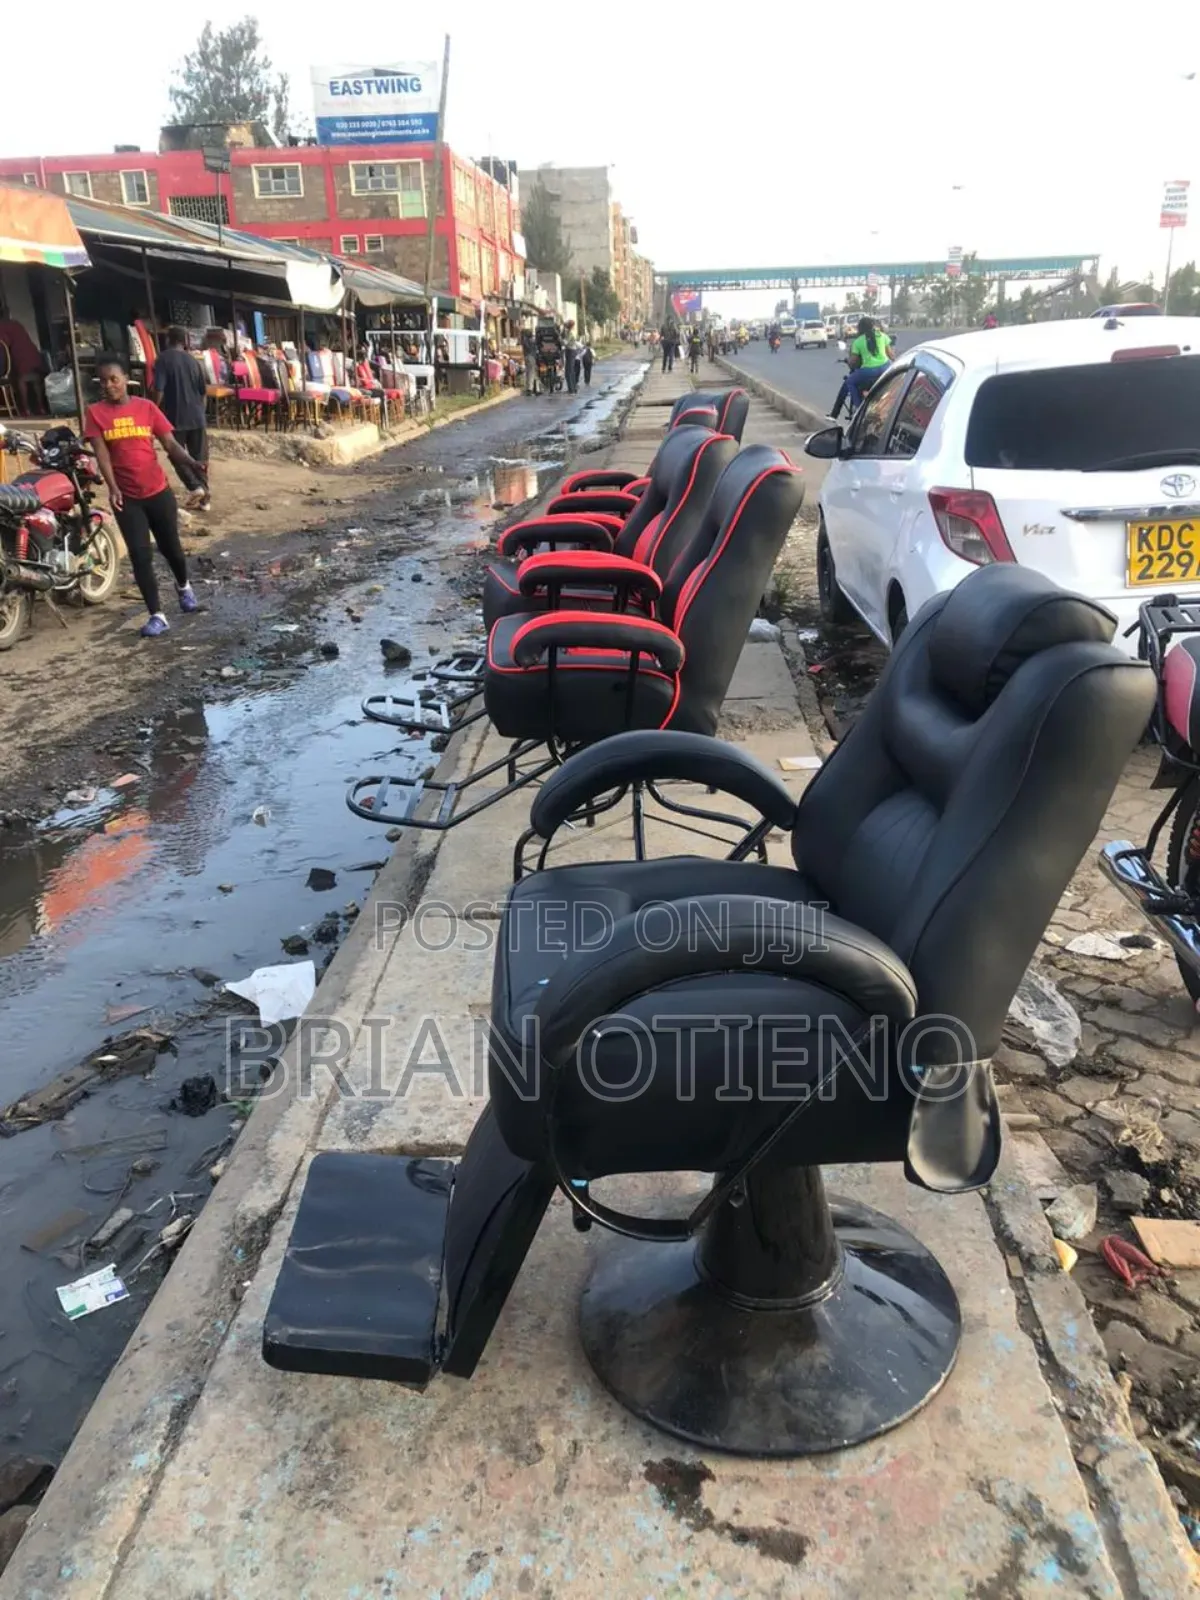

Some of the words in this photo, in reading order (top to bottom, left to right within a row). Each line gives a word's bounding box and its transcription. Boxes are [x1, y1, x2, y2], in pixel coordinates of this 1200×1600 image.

[329, 77, 422, 96] EASTWING
[1136, 523, 1195, 552] KDC
[1137, 550, 1200, 581] 229
